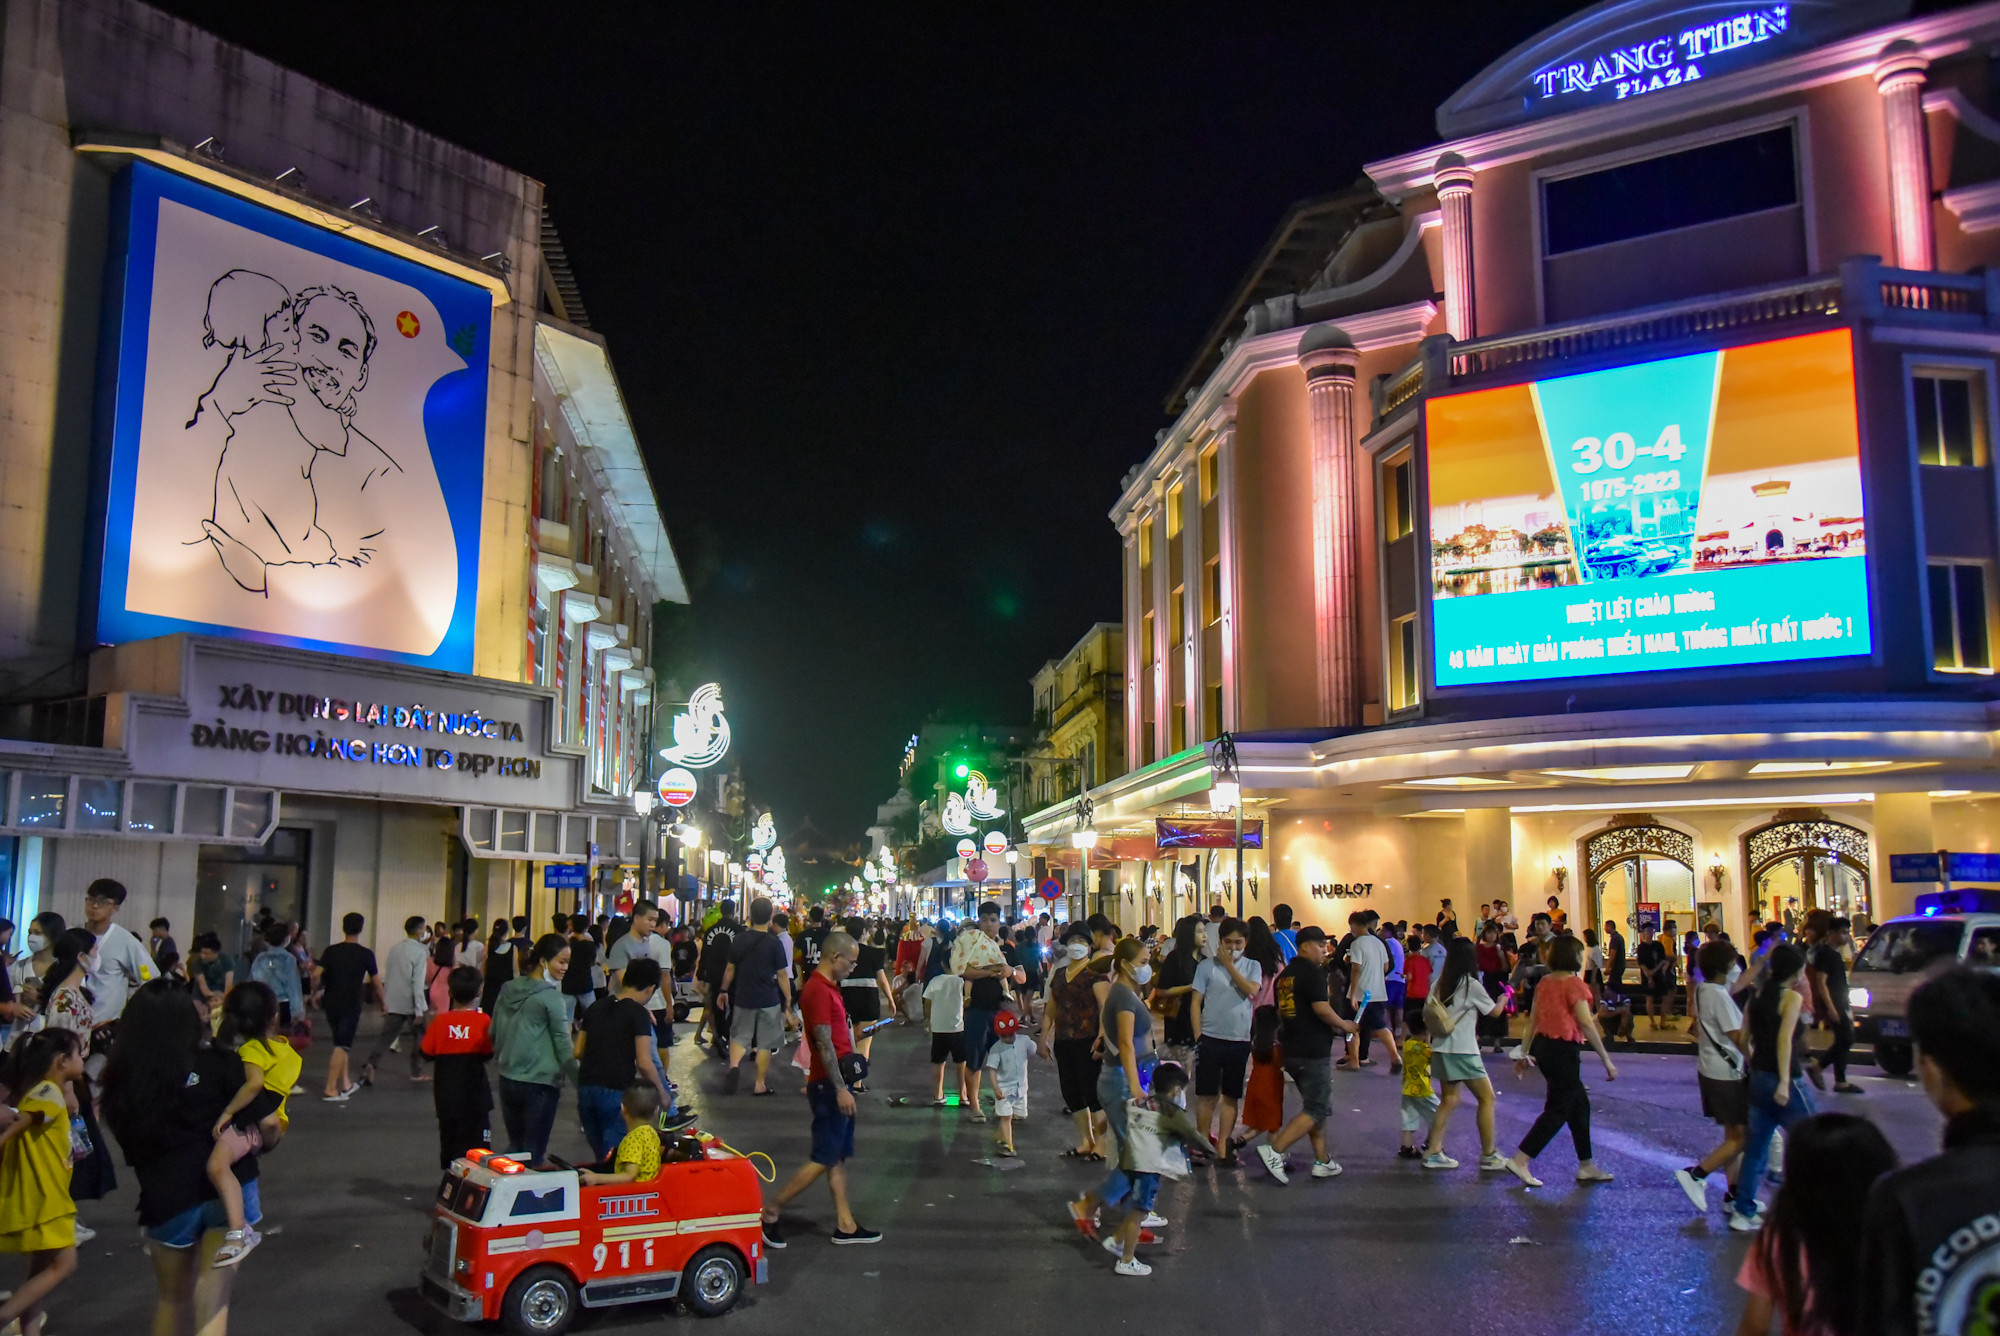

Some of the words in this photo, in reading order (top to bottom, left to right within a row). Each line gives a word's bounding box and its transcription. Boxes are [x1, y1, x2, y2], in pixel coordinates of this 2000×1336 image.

[1534, 36, 1673, 98] TRANG
[1679, 3, 1790, 60] TIEN
[1615, 62, 1702, 100] PLAZA
[1572, 424, 1687, 474] 30-4
[1580, 469, 1681, 501] 1975-2023
[220, 683, 275, 712] XÂY
[356, 701, 389, 729] LẠI
[501, 721, 524, 742] TA
[191, 718, 271, 752] ĐÀNG
[275, 730, 367, 762] HOÀNG
[425, 748, 454, 770] TO
[457, 752, 495, 778] ĐẸP
[1312, 883, 1373, 897] HUBLOT
[1639, 906, 1657, 914] SALE
[592, 1239, 654, 1272] 911
